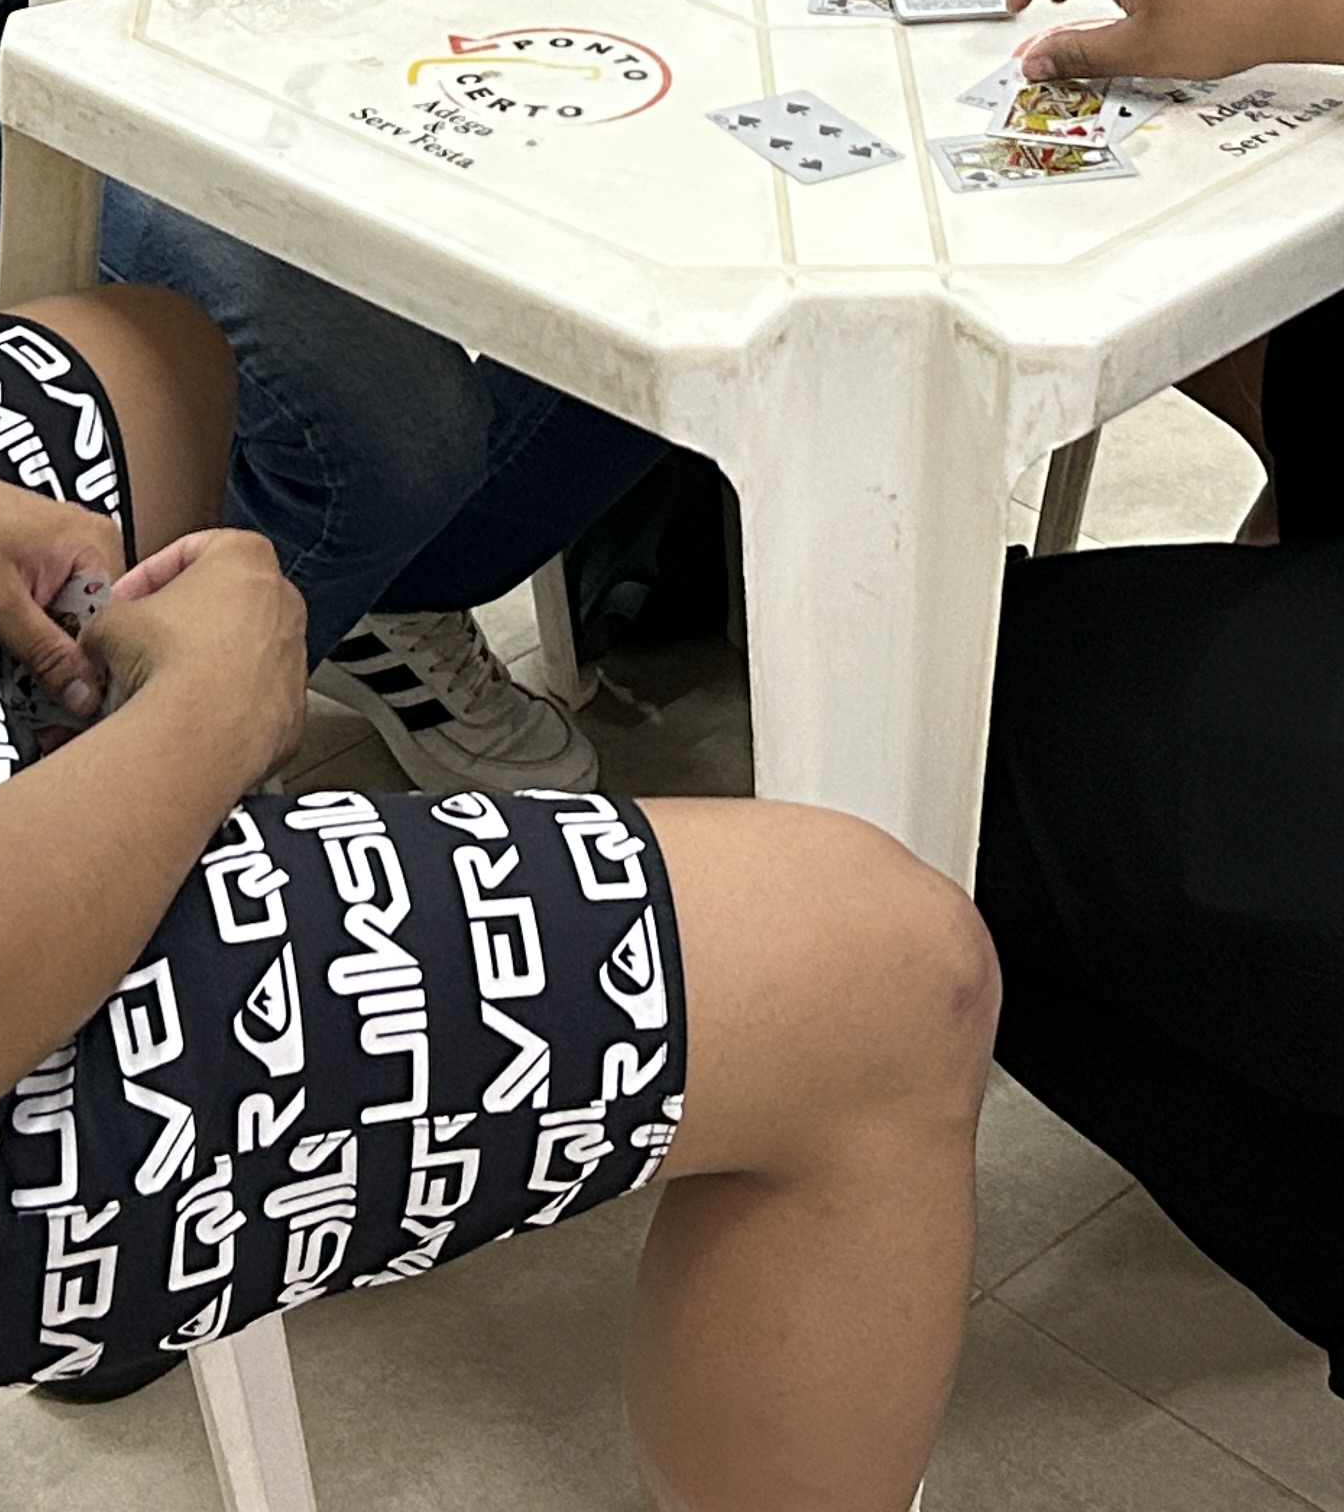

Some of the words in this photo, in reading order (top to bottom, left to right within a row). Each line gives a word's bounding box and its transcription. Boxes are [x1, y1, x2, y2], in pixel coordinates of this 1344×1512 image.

[512, 37, 649, 82] PONTO
[455, 72, 585, 119] CERTO
[350, 106, 411, 137] Serv
[408, 131, 476, 170] Festa
[1219, 129, 1281, 158] Serv
